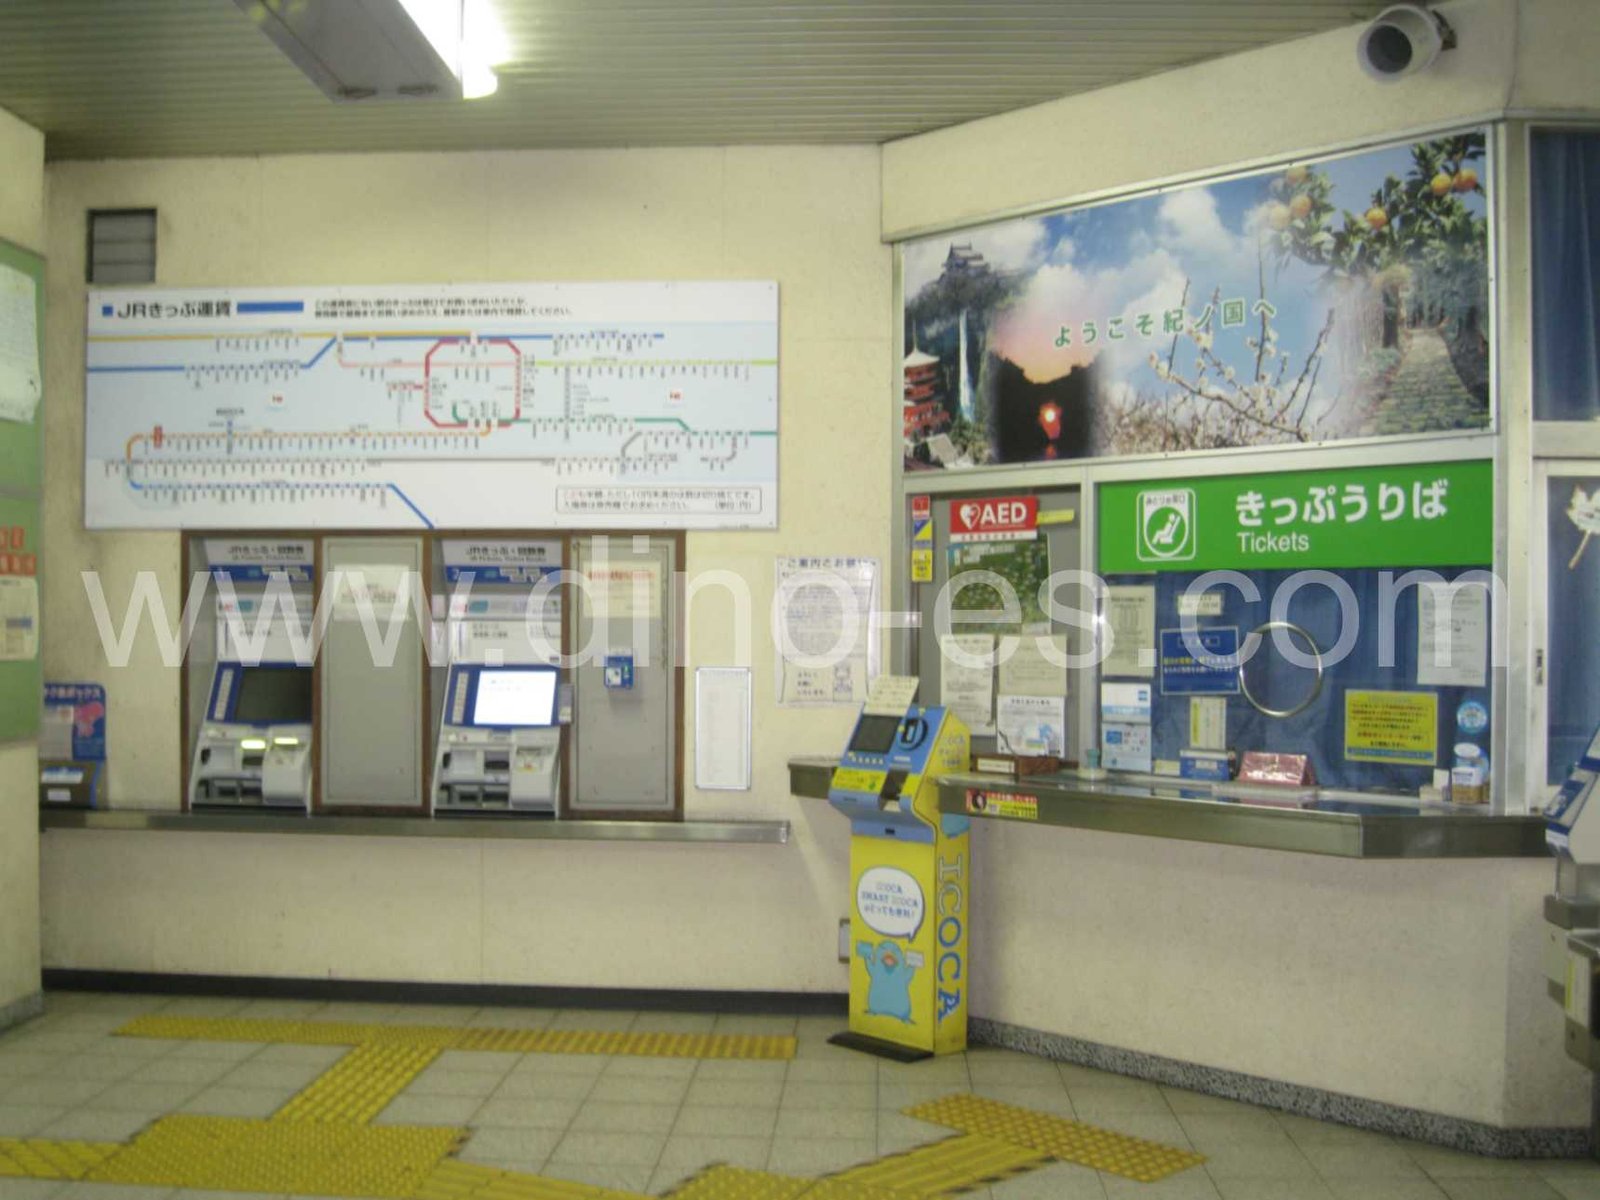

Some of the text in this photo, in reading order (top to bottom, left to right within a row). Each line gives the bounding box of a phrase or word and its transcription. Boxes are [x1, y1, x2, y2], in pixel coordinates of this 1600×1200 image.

[117, 301, 231, 318] JRきっぷ運賃
[1054, 298, 1277, 348] ようこそ紀ノ国へ
[980, 502, 1027, 524] AED
[1236, 479, 1448, 526] きっぷうりば
[1237, 532, 1309, 553] Tickets
[938, 855, 962, 1024] ICOCA
